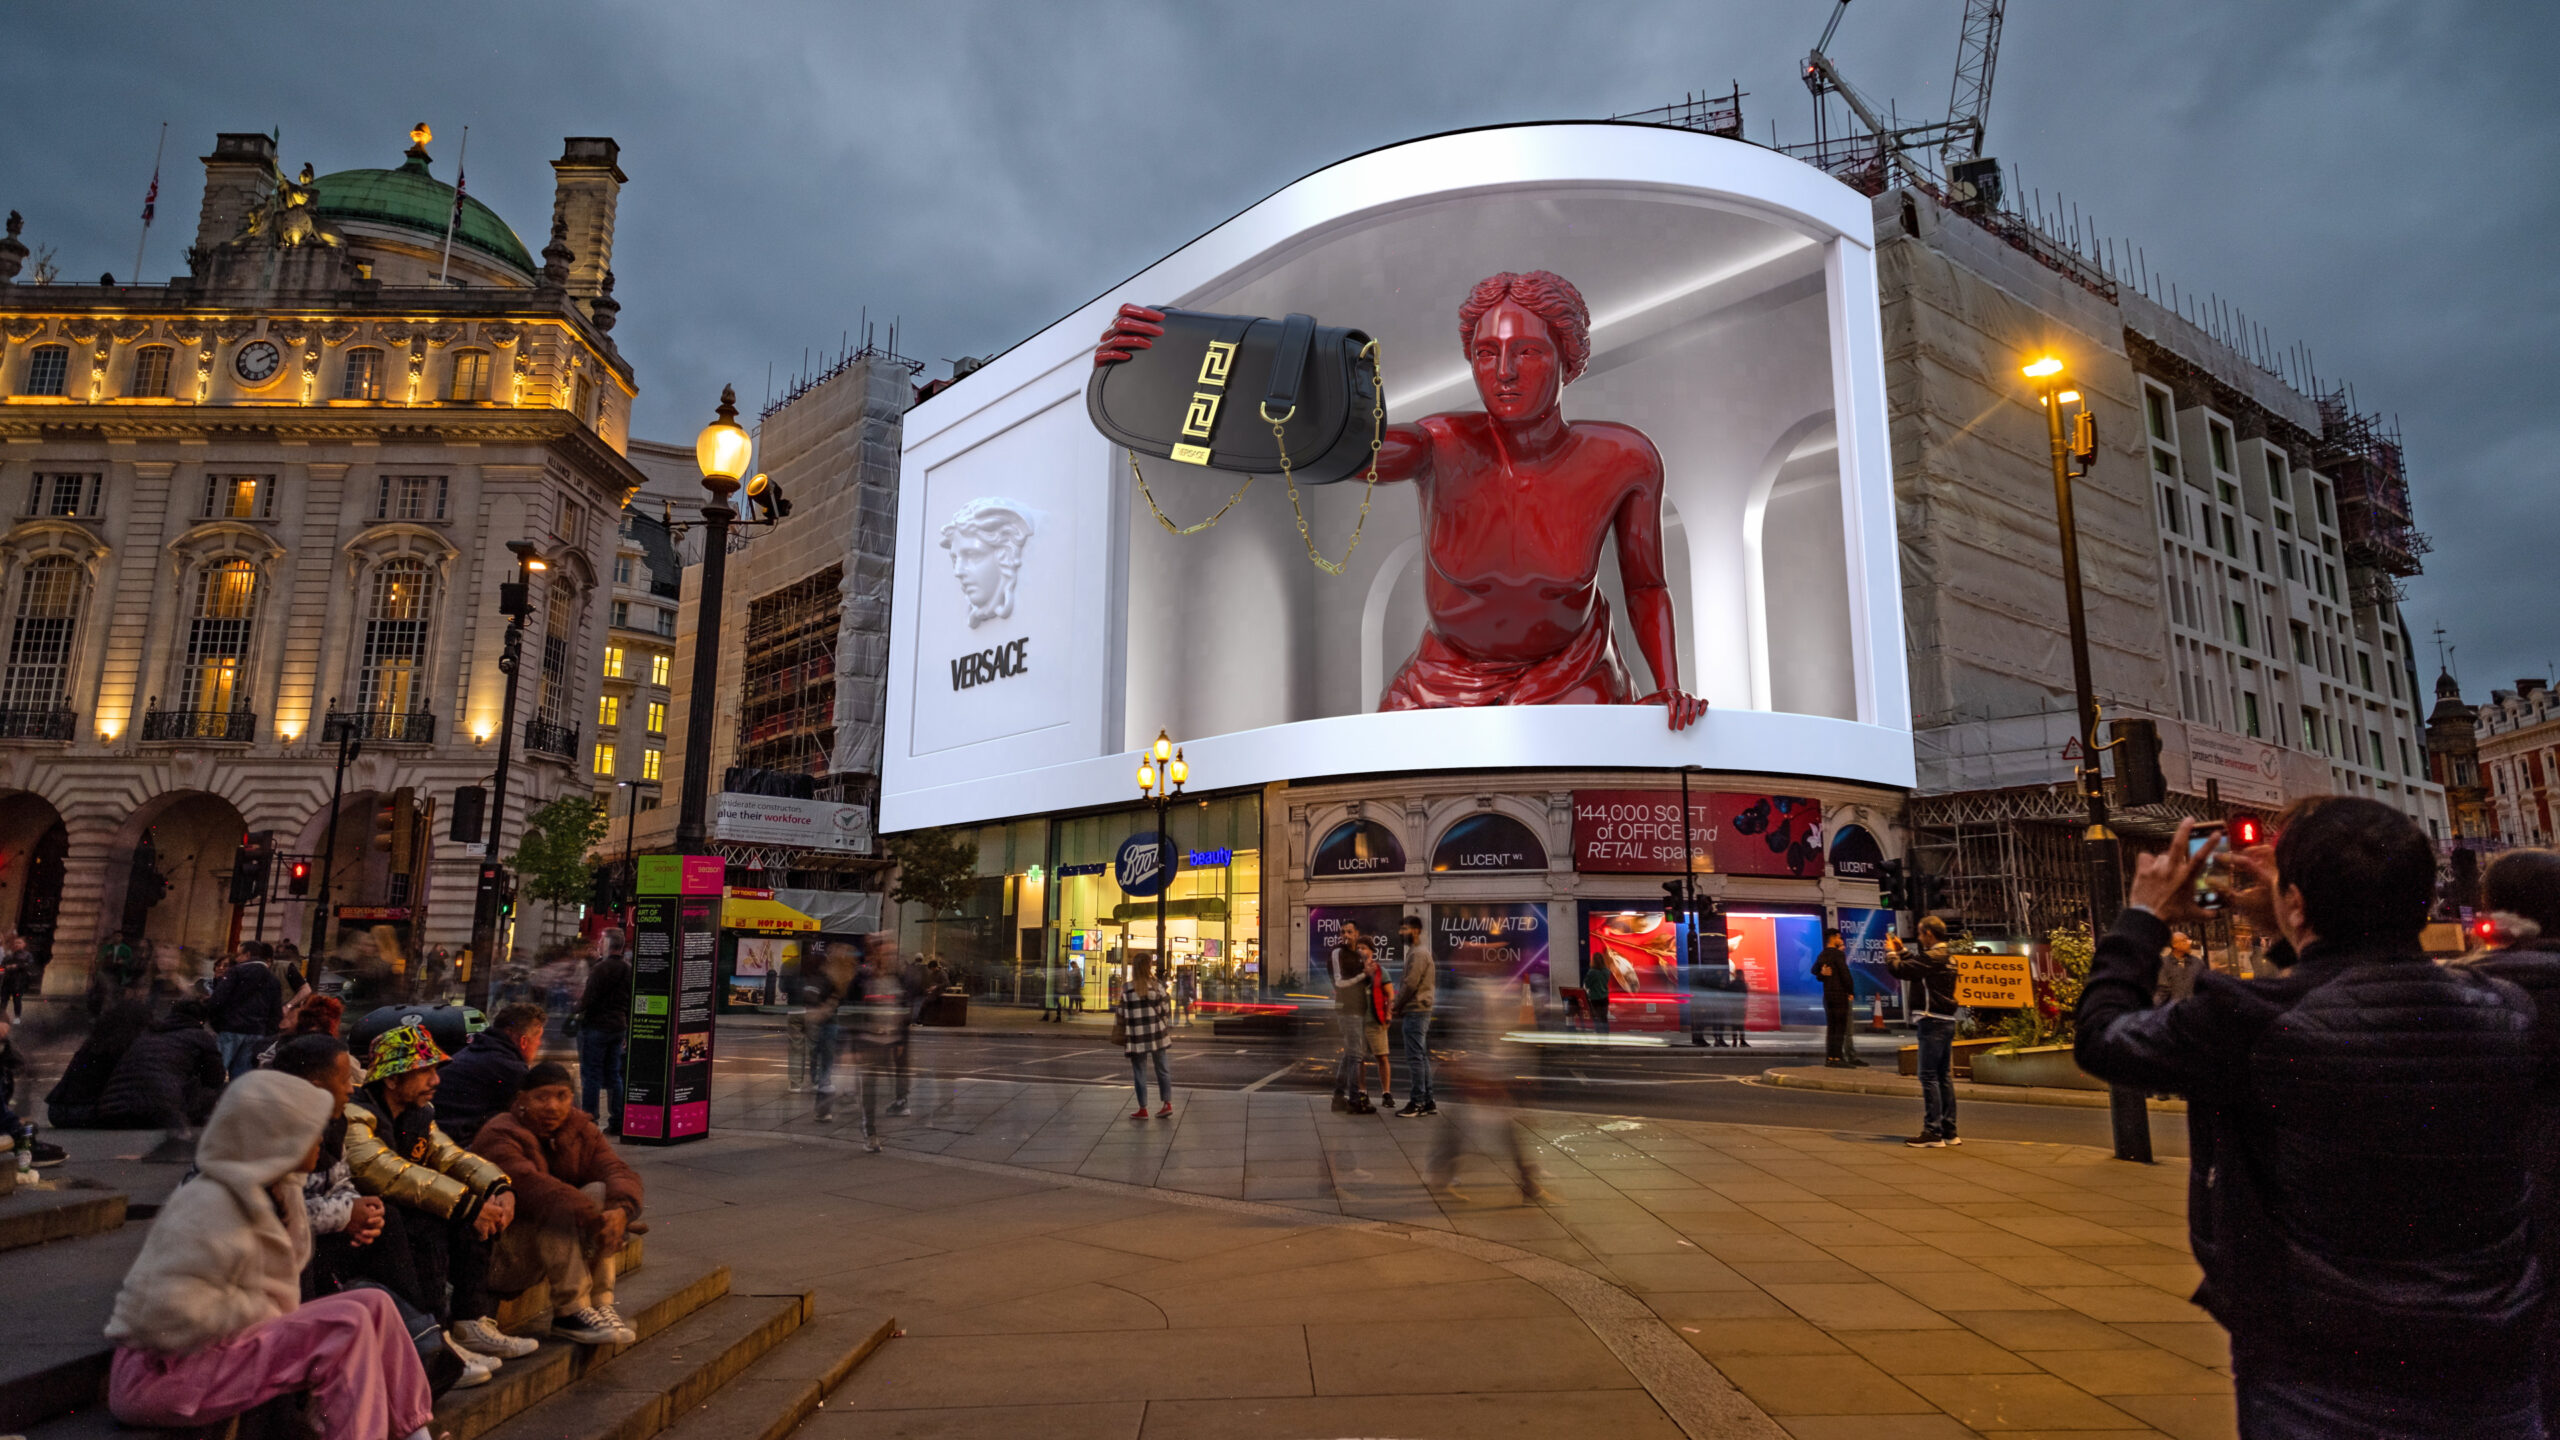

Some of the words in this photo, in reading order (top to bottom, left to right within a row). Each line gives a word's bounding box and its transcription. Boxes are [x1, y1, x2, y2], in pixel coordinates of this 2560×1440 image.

[951, 637, 1029, 691] VERSACE
[757, 802, 802, 813] constructors
[1575, 804, 1649, 823] 144,000
[1654, 804, 1681, 822] SQ
[717, 809, 737, 818] alue
[740, 810, 762, 821] their
[764, 813, 812, 825] workforce
[1597, 823, 1613, 839] of
[1618, 823, 1682, 840] OFFICE
[1687, 825, 1718, 841] and
[1190, 847, 1233, 867] beauty
[1587, 842, 1648, 859] RETAIL
[1338, 857, 1378, 870] LUCENT
[1460, 853, 1510, 866] LUCENT
[1839, 861, 1866, 873] LUCENT
[757, 919, 774, 927] HOT
[776, 920, 793, 928] DOG
[1440, 916, 1538, 931] ILLUMINATED
[1840, 920, 1866, 934] PRIME
[1450, 933, 1465, 949] by
[1469, 934, 1487, 946] an
[1483, 947, 1521, 962] ICON
[1974, 960, 2024, 971] Access
[1958, 974, 2022, 986] Trafalgar
[1962, 988, 2016, 1000] Square
